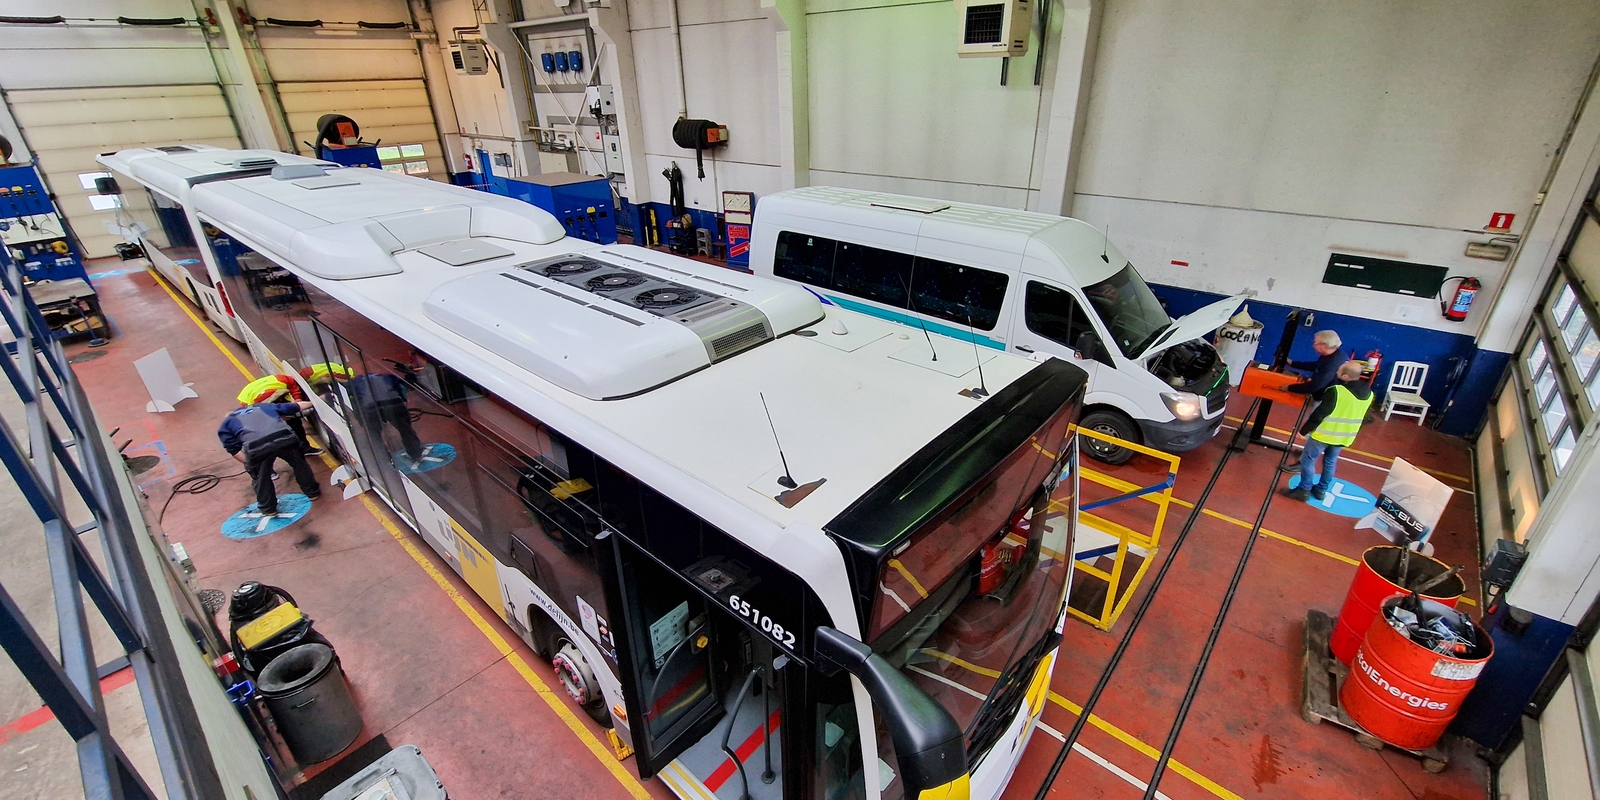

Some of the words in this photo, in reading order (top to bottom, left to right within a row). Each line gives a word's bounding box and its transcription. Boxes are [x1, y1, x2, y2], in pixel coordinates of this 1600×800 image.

[1380, 499, 1425, 533] FIXBUS
[529, 587, 580, 636] www.delijn.be
[729, 594, 797, 650] 651082
